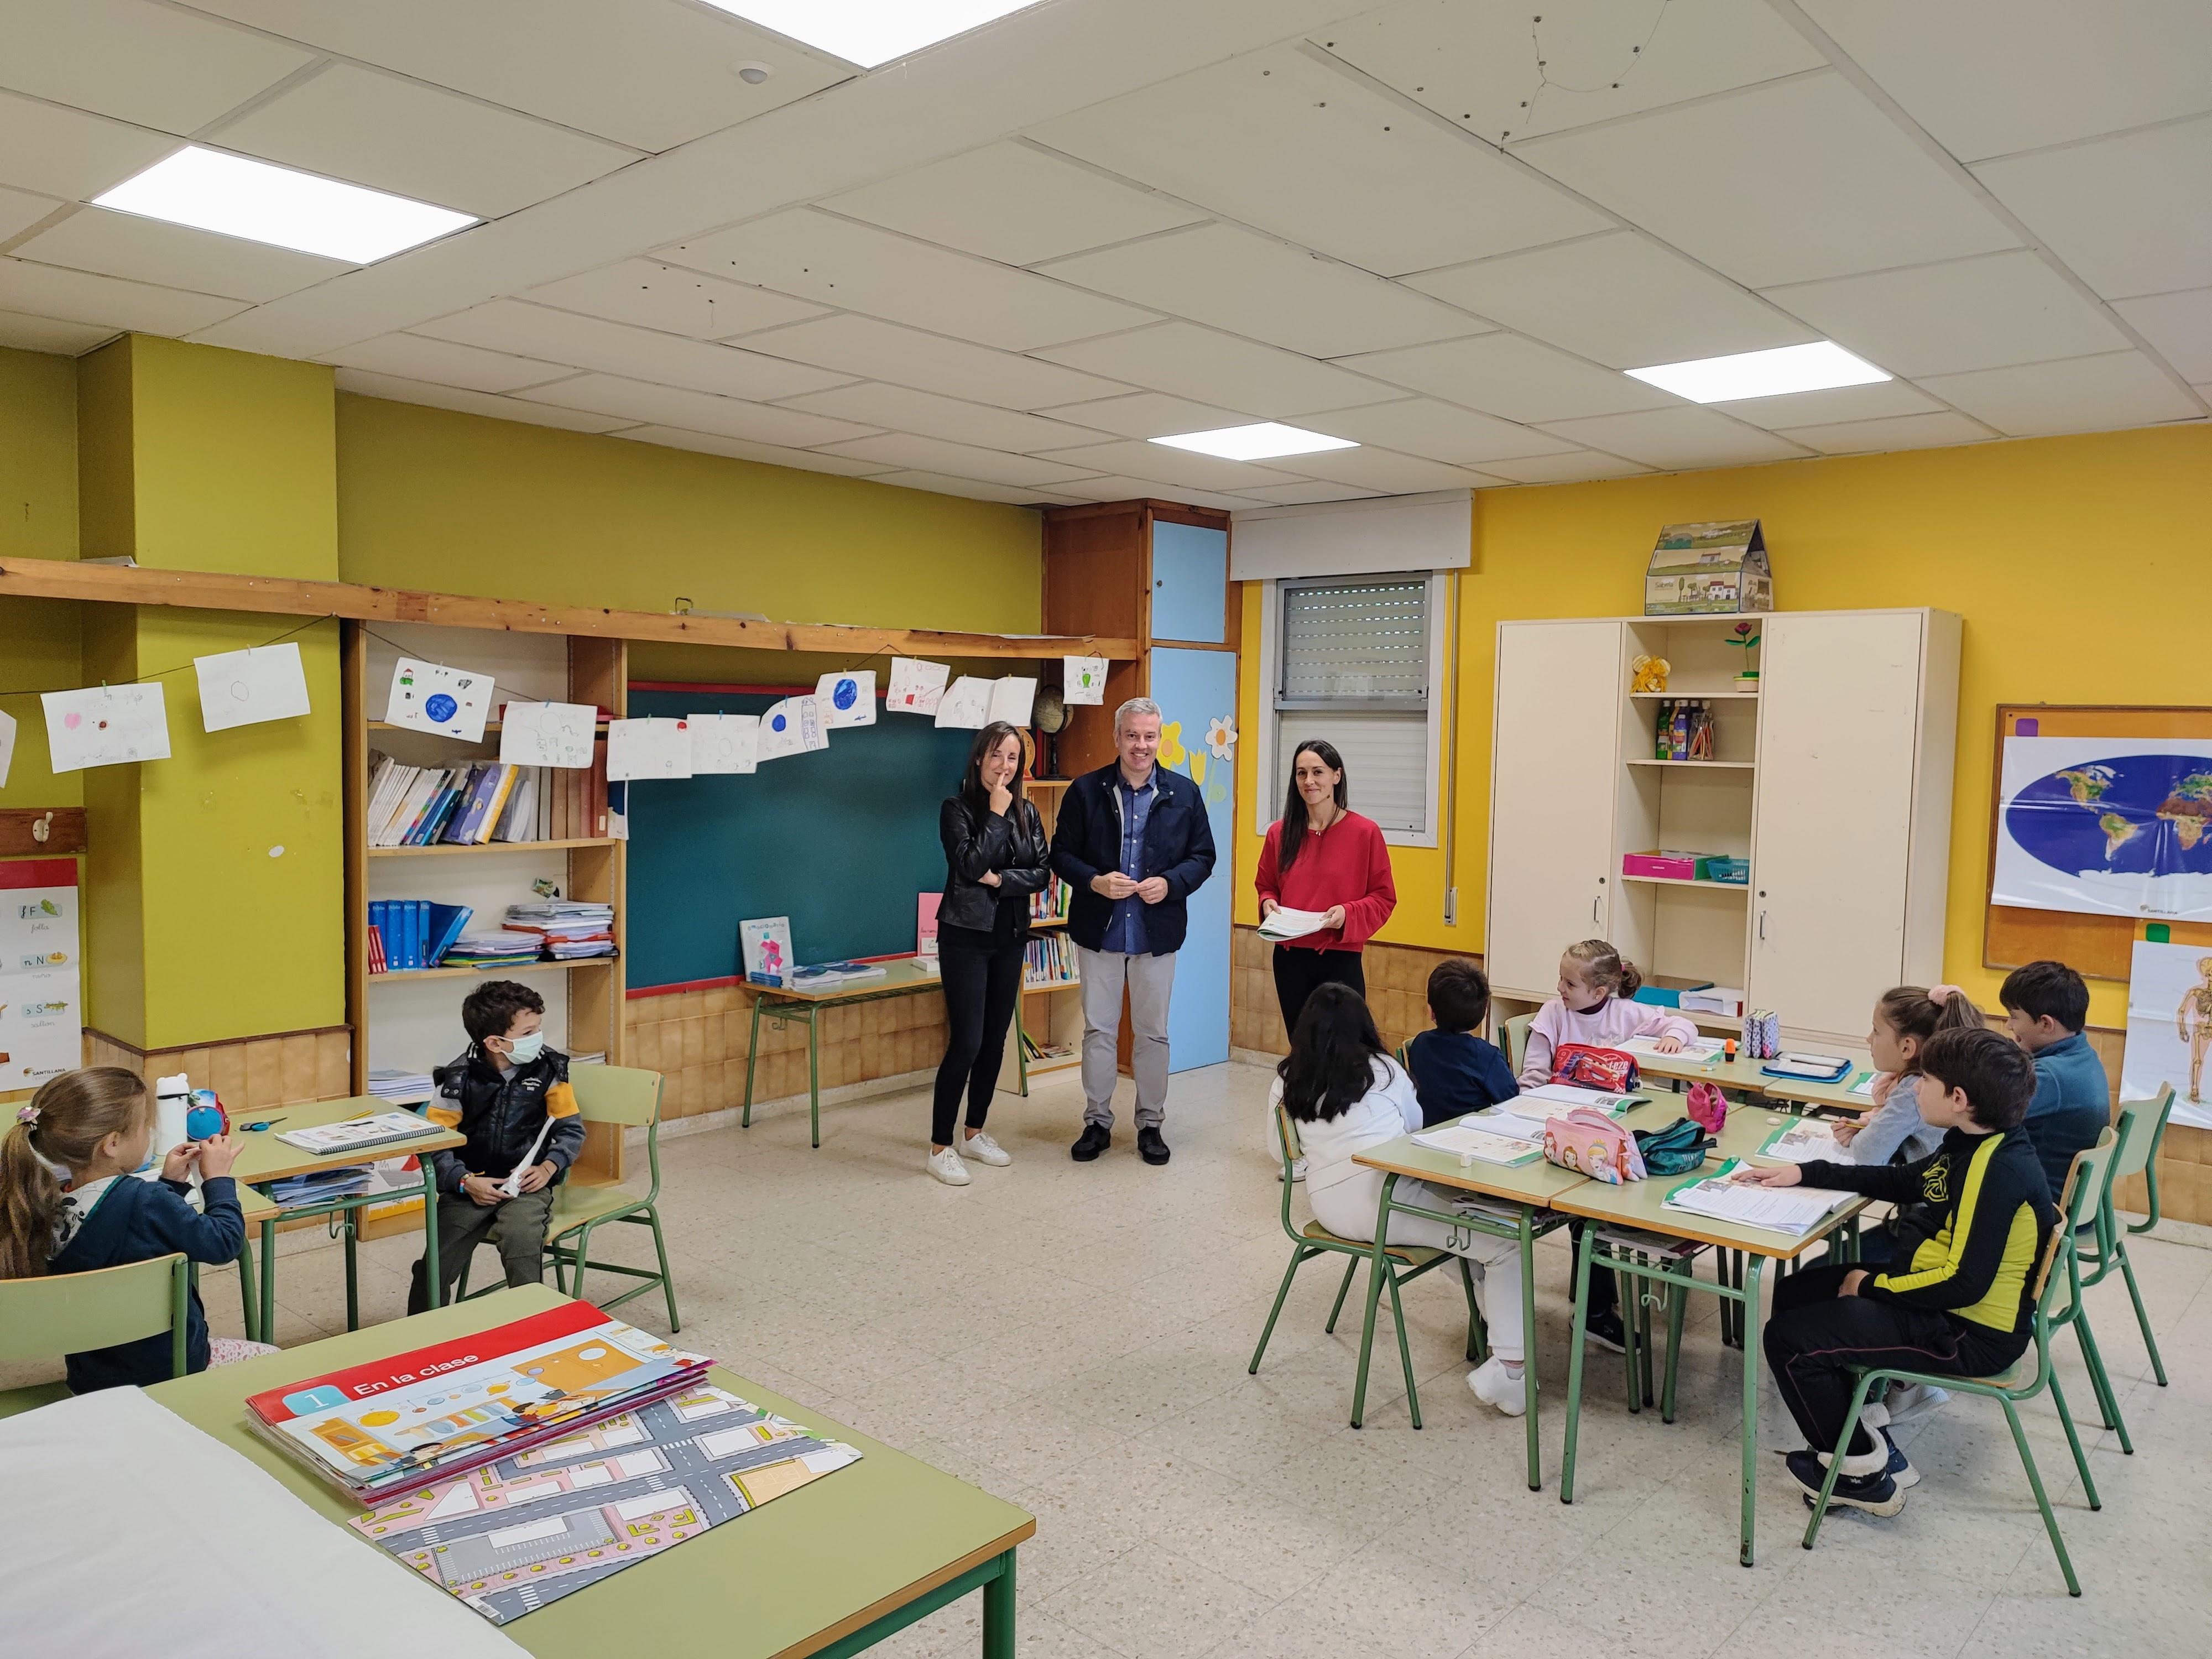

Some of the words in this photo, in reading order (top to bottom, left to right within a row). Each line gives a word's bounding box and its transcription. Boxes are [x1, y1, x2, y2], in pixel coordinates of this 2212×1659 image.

[30, 906, 36, 916] F
[36, 956, 44, 964] N
[36, 1004, 43, 1014] S
[32, 1068, 66, 1076] SANTILLANA
[353, 1381, 389, 1396] En
[389, 1373, 417, 1385] la
[419, 1354, 479, 1376] clase
[304, 1393, 330, 1409] 1
